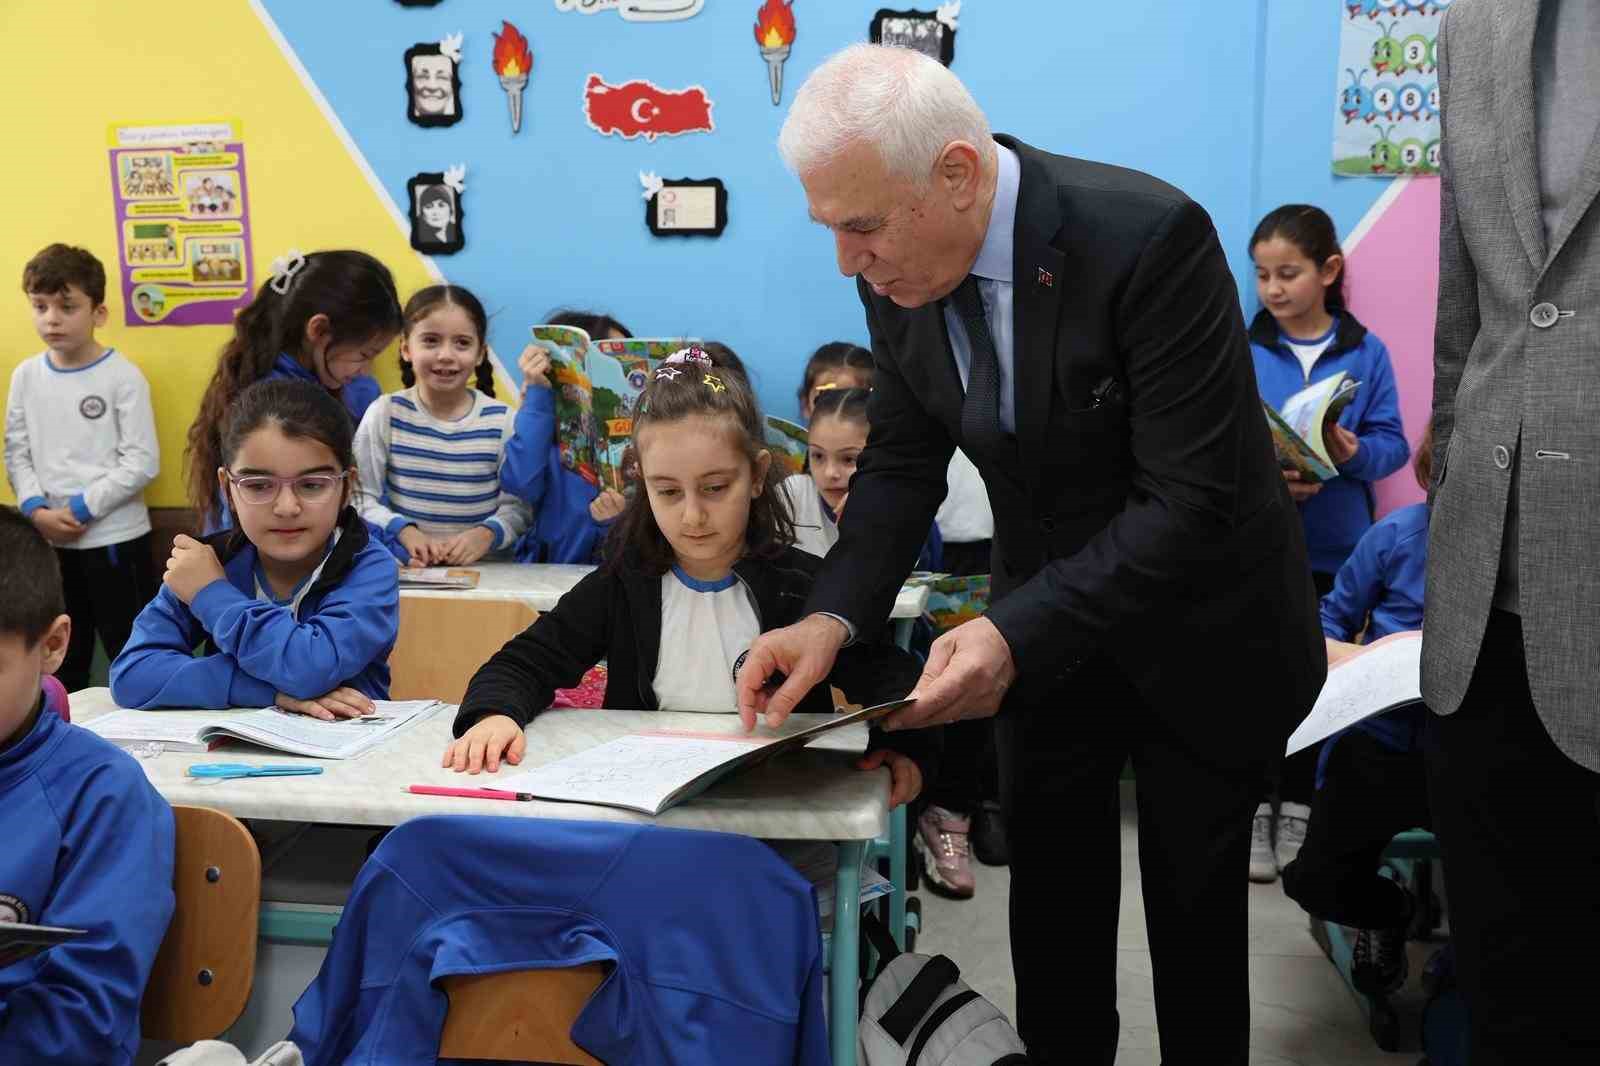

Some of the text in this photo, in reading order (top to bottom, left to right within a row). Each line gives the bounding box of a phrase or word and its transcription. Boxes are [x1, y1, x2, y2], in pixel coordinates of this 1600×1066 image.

[1410, 46, 1418, 60] 3
[1379, 92, 1388, 105] 4
[1405, 92, 1415, 106] 8
[1406, 149, 1415, 163] 5
